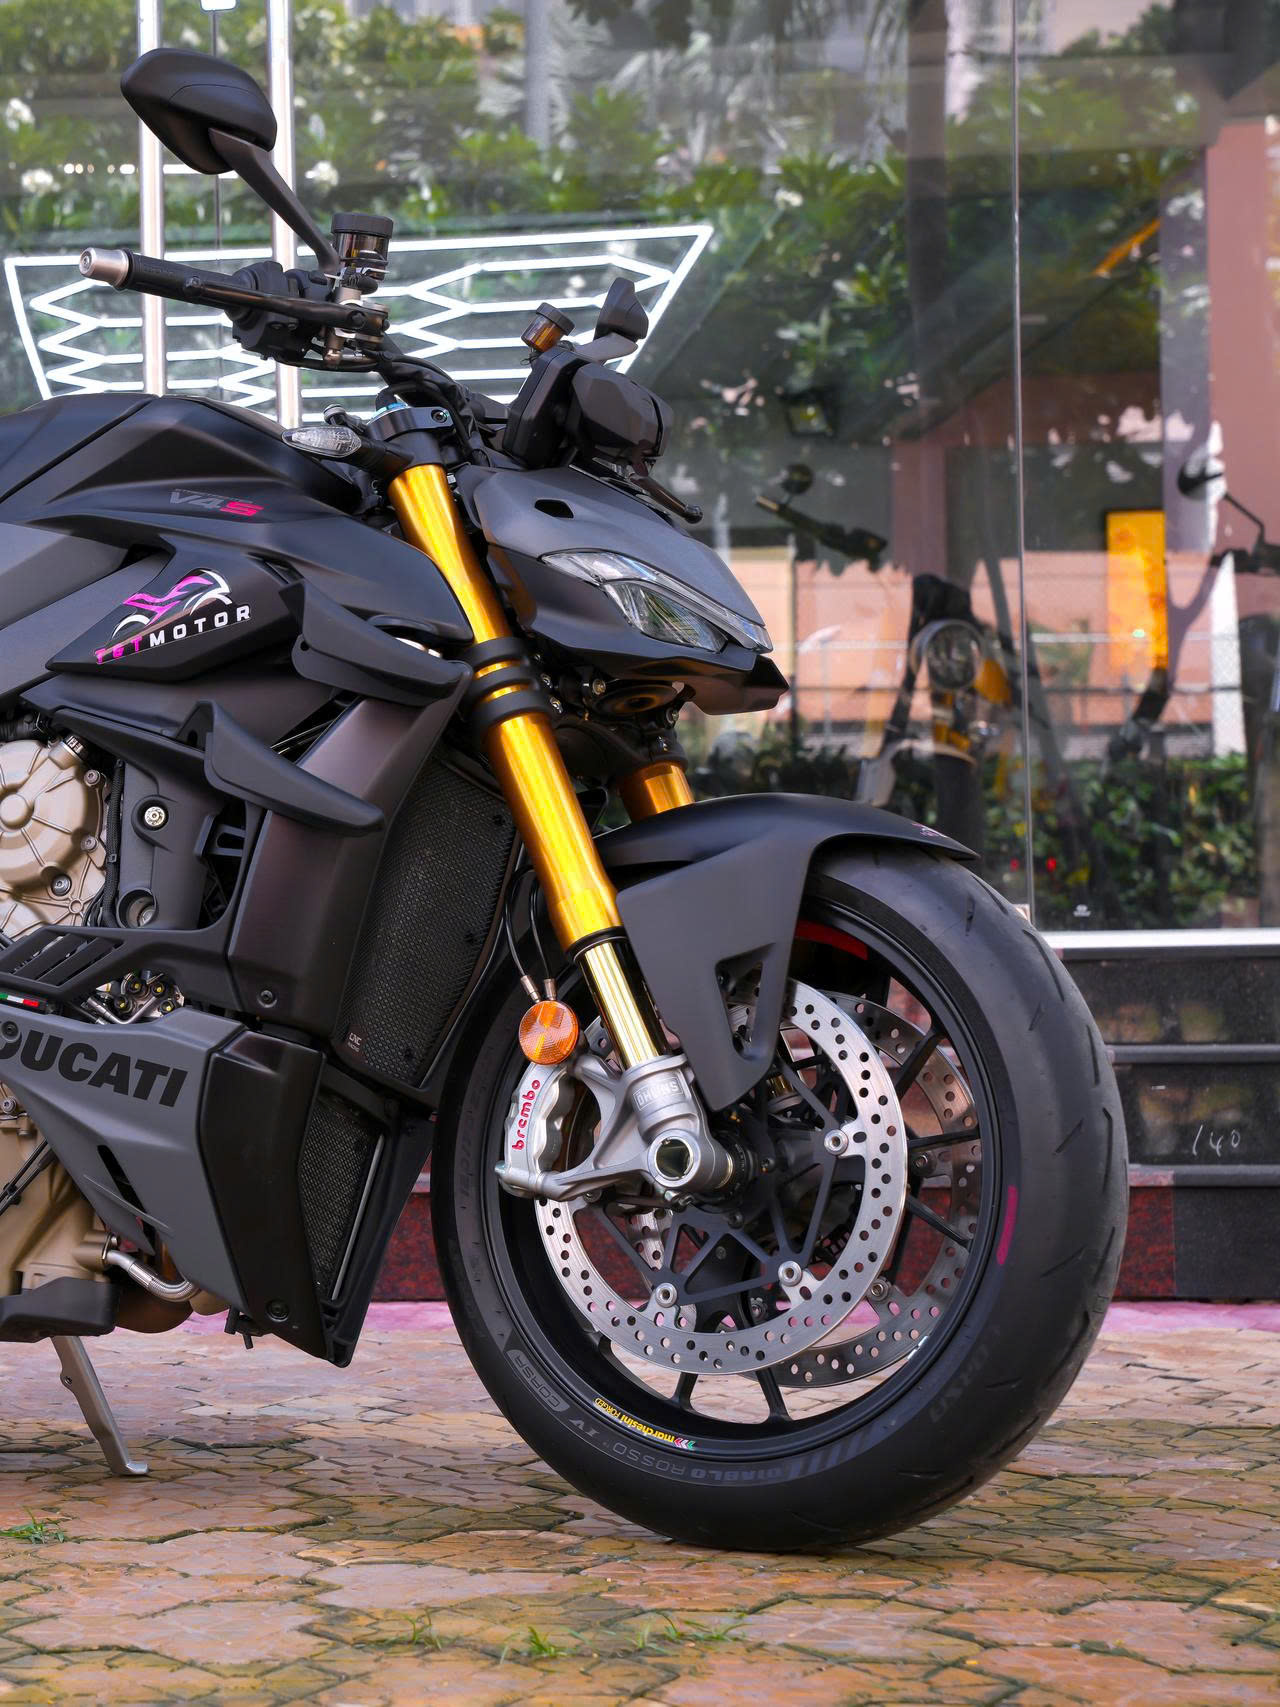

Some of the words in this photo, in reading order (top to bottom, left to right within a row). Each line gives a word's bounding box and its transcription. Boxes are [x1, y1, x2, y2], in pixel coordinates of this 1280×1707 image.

[149, 605, 251, 647] MOTOR
[511, 1079, 541, 1151] brembo
[513, 1354, 561, 1408] CORSA
[594, 1396, 621, 1418] FORGED
[620, 1414, 676, 1444] marchesini
[613, 1442, 686, 1476] ROSSO
[691, 1466, 779, 1481] DIABLO
